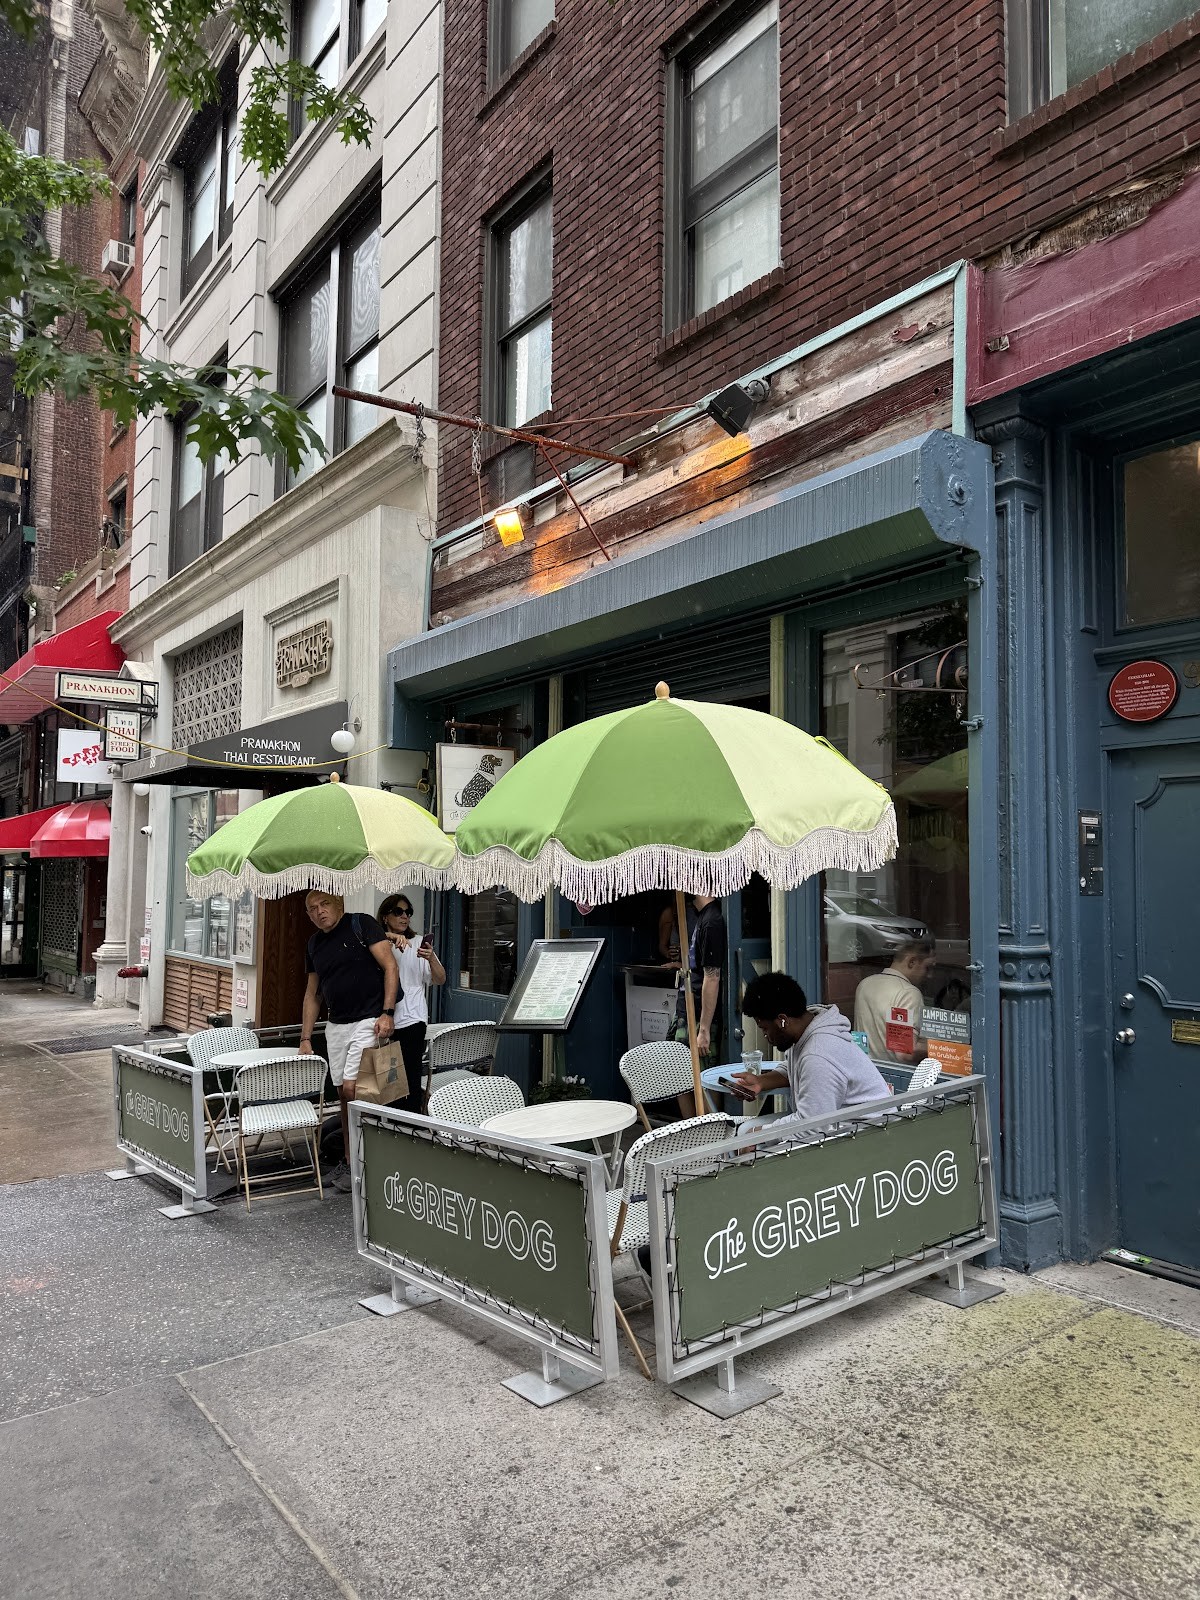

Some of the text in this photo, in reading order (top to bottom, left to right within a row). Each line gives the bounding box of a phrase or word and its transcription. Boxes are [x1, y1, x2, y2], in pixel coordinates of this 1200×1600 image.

[66, 681, 136, 696] PRANAKHON
[111, 726, 135, 736] THAI
[240, 737, 301, 752] PRANAKHON
[223, 751, 316, 766] THAI RESTAURANT
[922, 1009, 967, 1024] CAMPUS CASH
[938, 1044, 957, 1053] deliver
[937, 1052, 960, 1061] Grubhub
[135, 1092, 161, 1128] GREY
[162, 1103, 190, 1142] DOG
[383, 1171, 557, 1271] The GREY DOG
[703, 1150, 959, 1280] The GREY DOG
